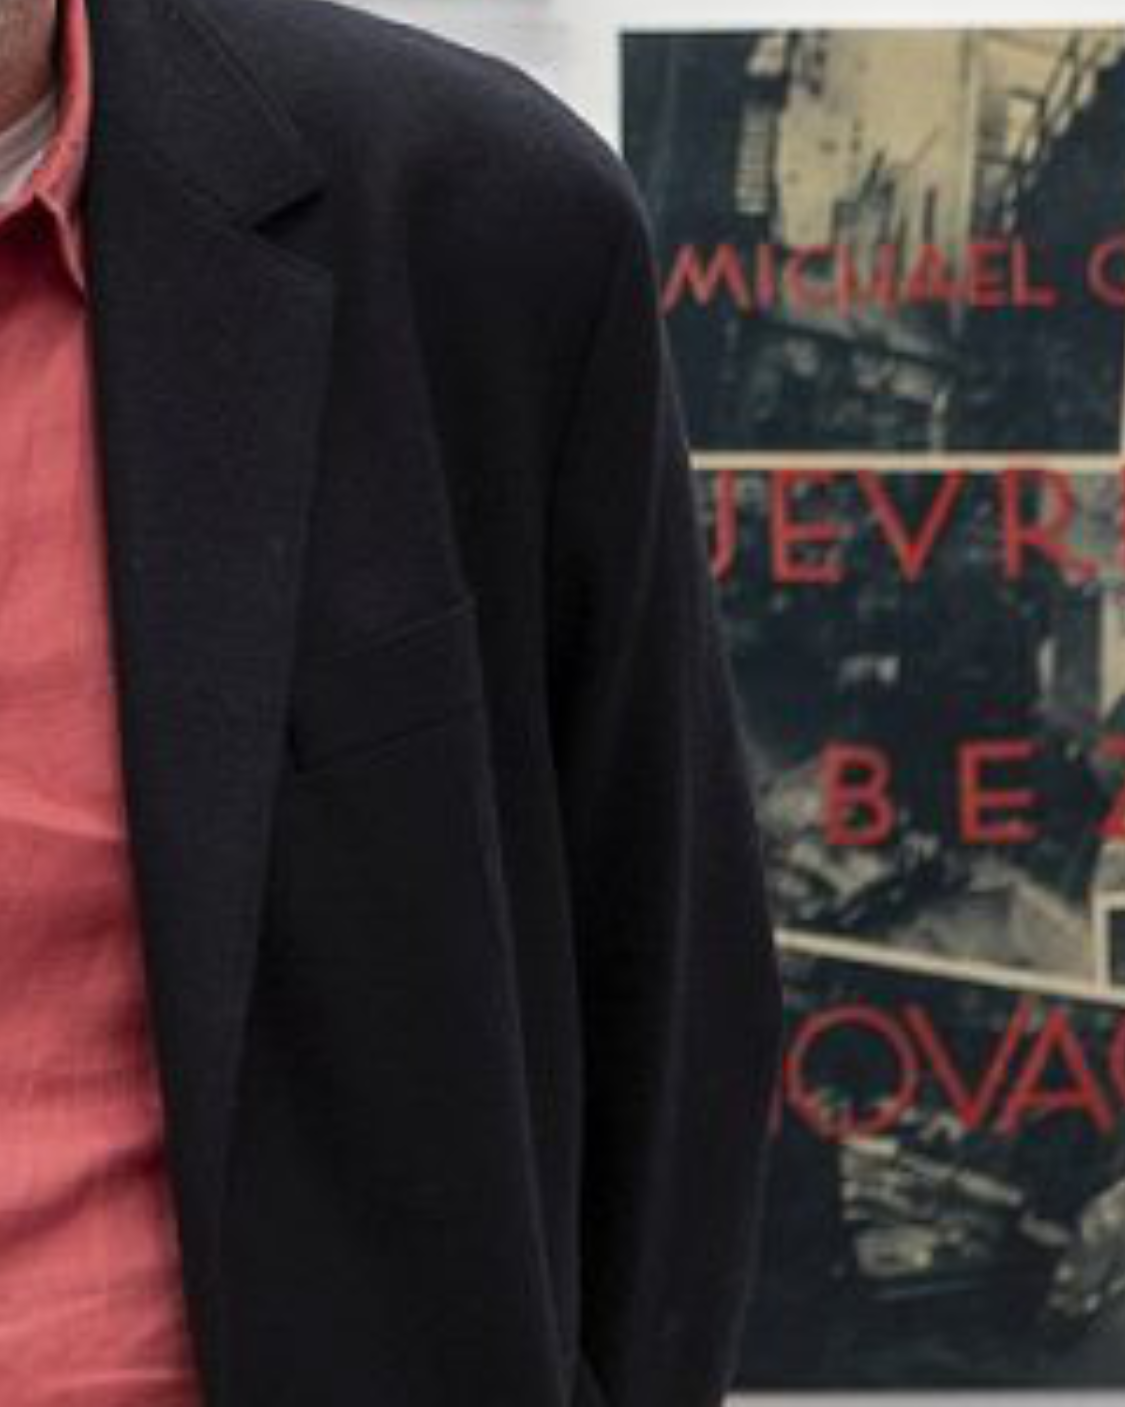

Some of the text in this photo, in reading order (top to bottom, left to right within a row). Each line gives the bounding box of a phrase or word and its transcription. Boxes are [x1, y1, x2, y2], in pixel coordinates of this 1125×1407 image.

[660, 239, 1058, 318] MICHAEL
[709, 464, 1125, 582] JEVR
[768, 1000, 1125, 1141] OVA
